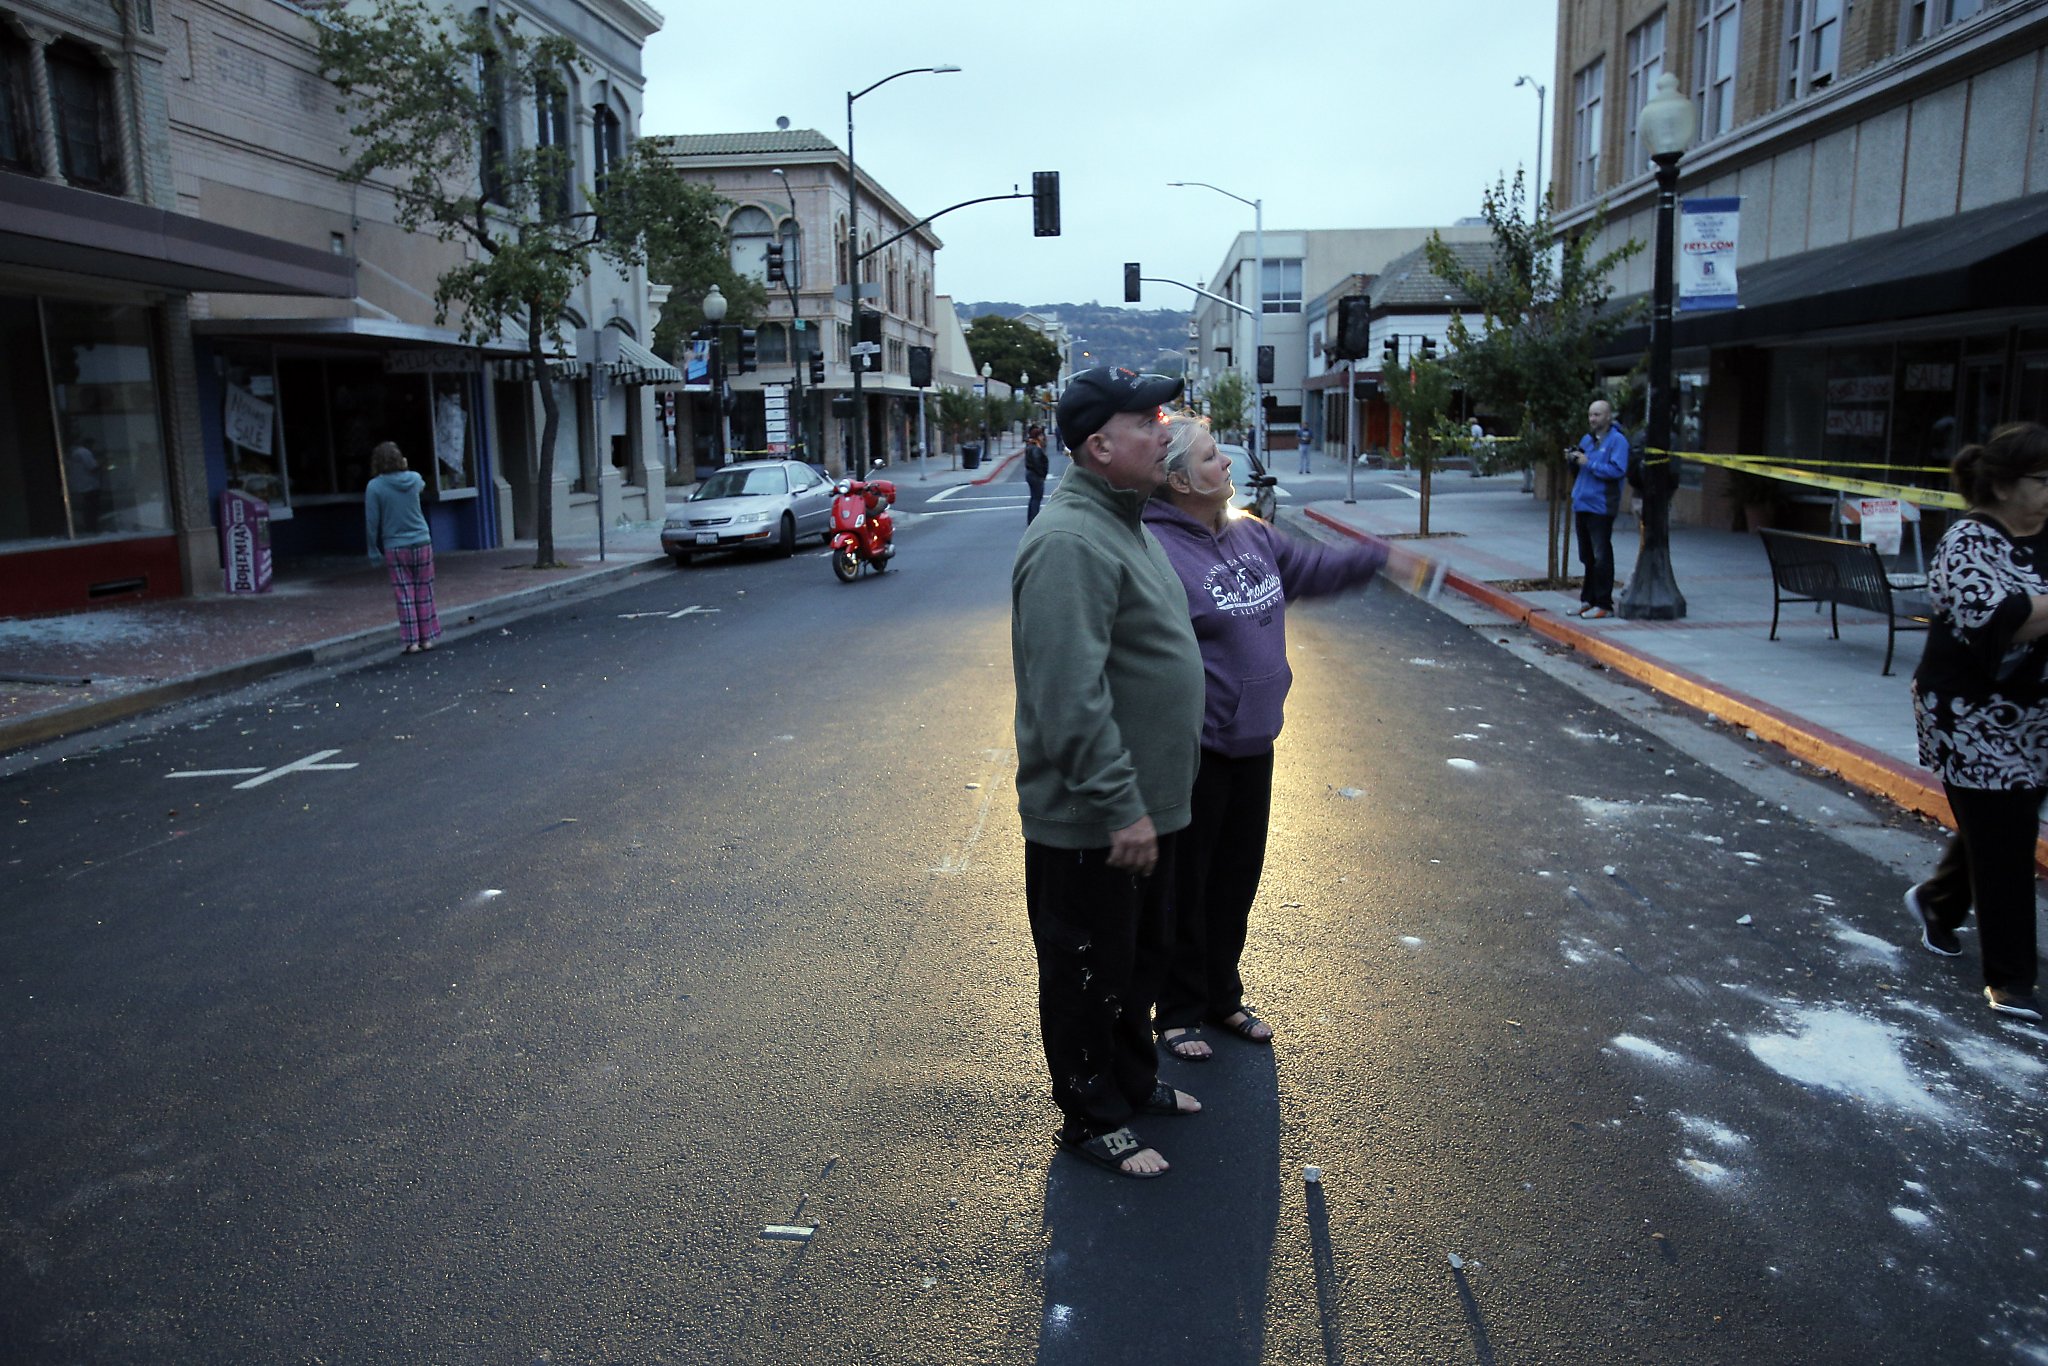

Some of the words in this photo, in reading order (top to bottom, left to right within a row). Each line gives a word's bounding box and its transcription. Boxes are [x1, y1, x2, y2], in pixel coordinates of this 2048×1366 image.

[235, 522, 251, 590] BOHEMIAN
[1212, 586, 1242, 607] San
[1231, 590, 1284, 617] CALIFORNI
